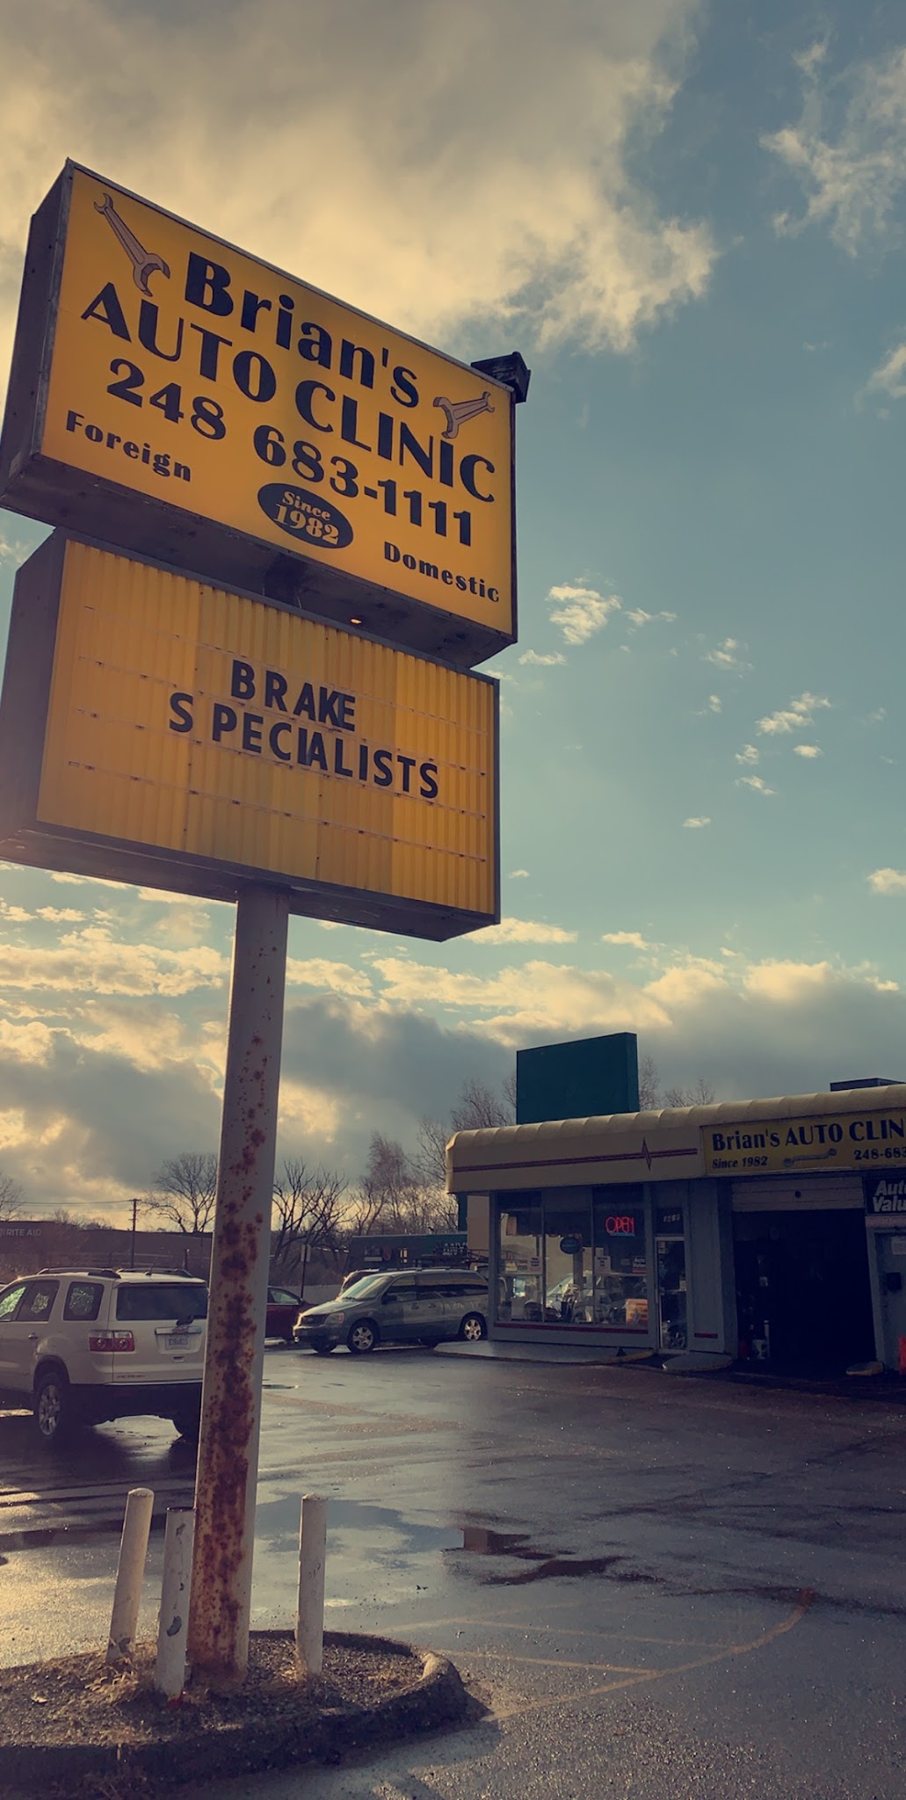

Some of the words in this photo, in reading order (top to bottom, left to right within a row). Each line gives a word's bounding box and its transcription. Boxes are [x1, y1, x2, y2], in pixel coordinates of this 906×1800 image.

[184, 251, 420, 409] Brian's
[81, 281, 277, 403] AUTO
[295, 379, 496, 503] CLINIC
[65, 410, 192, 482] Foreign
[106, 358, 227, 441] 248
[253, 424, 472, 547] 683-1111
[273, 503, 340, 545] 1982
[282, 491, 331, 521] Since
[384, 541, 500, 603] Domestic
[231, 659, 356, 732] BRAKE
[712, 1128, 780, 1151] Brian's
[785, 1123, 843, 1146] AUTO
[712, 1158, 738, 1169] Since
[742, 1155, 768, 1167] 1982
[874, 1180, 906, 1196] Aut
[605, 1216, 635, 1233] OPEN
